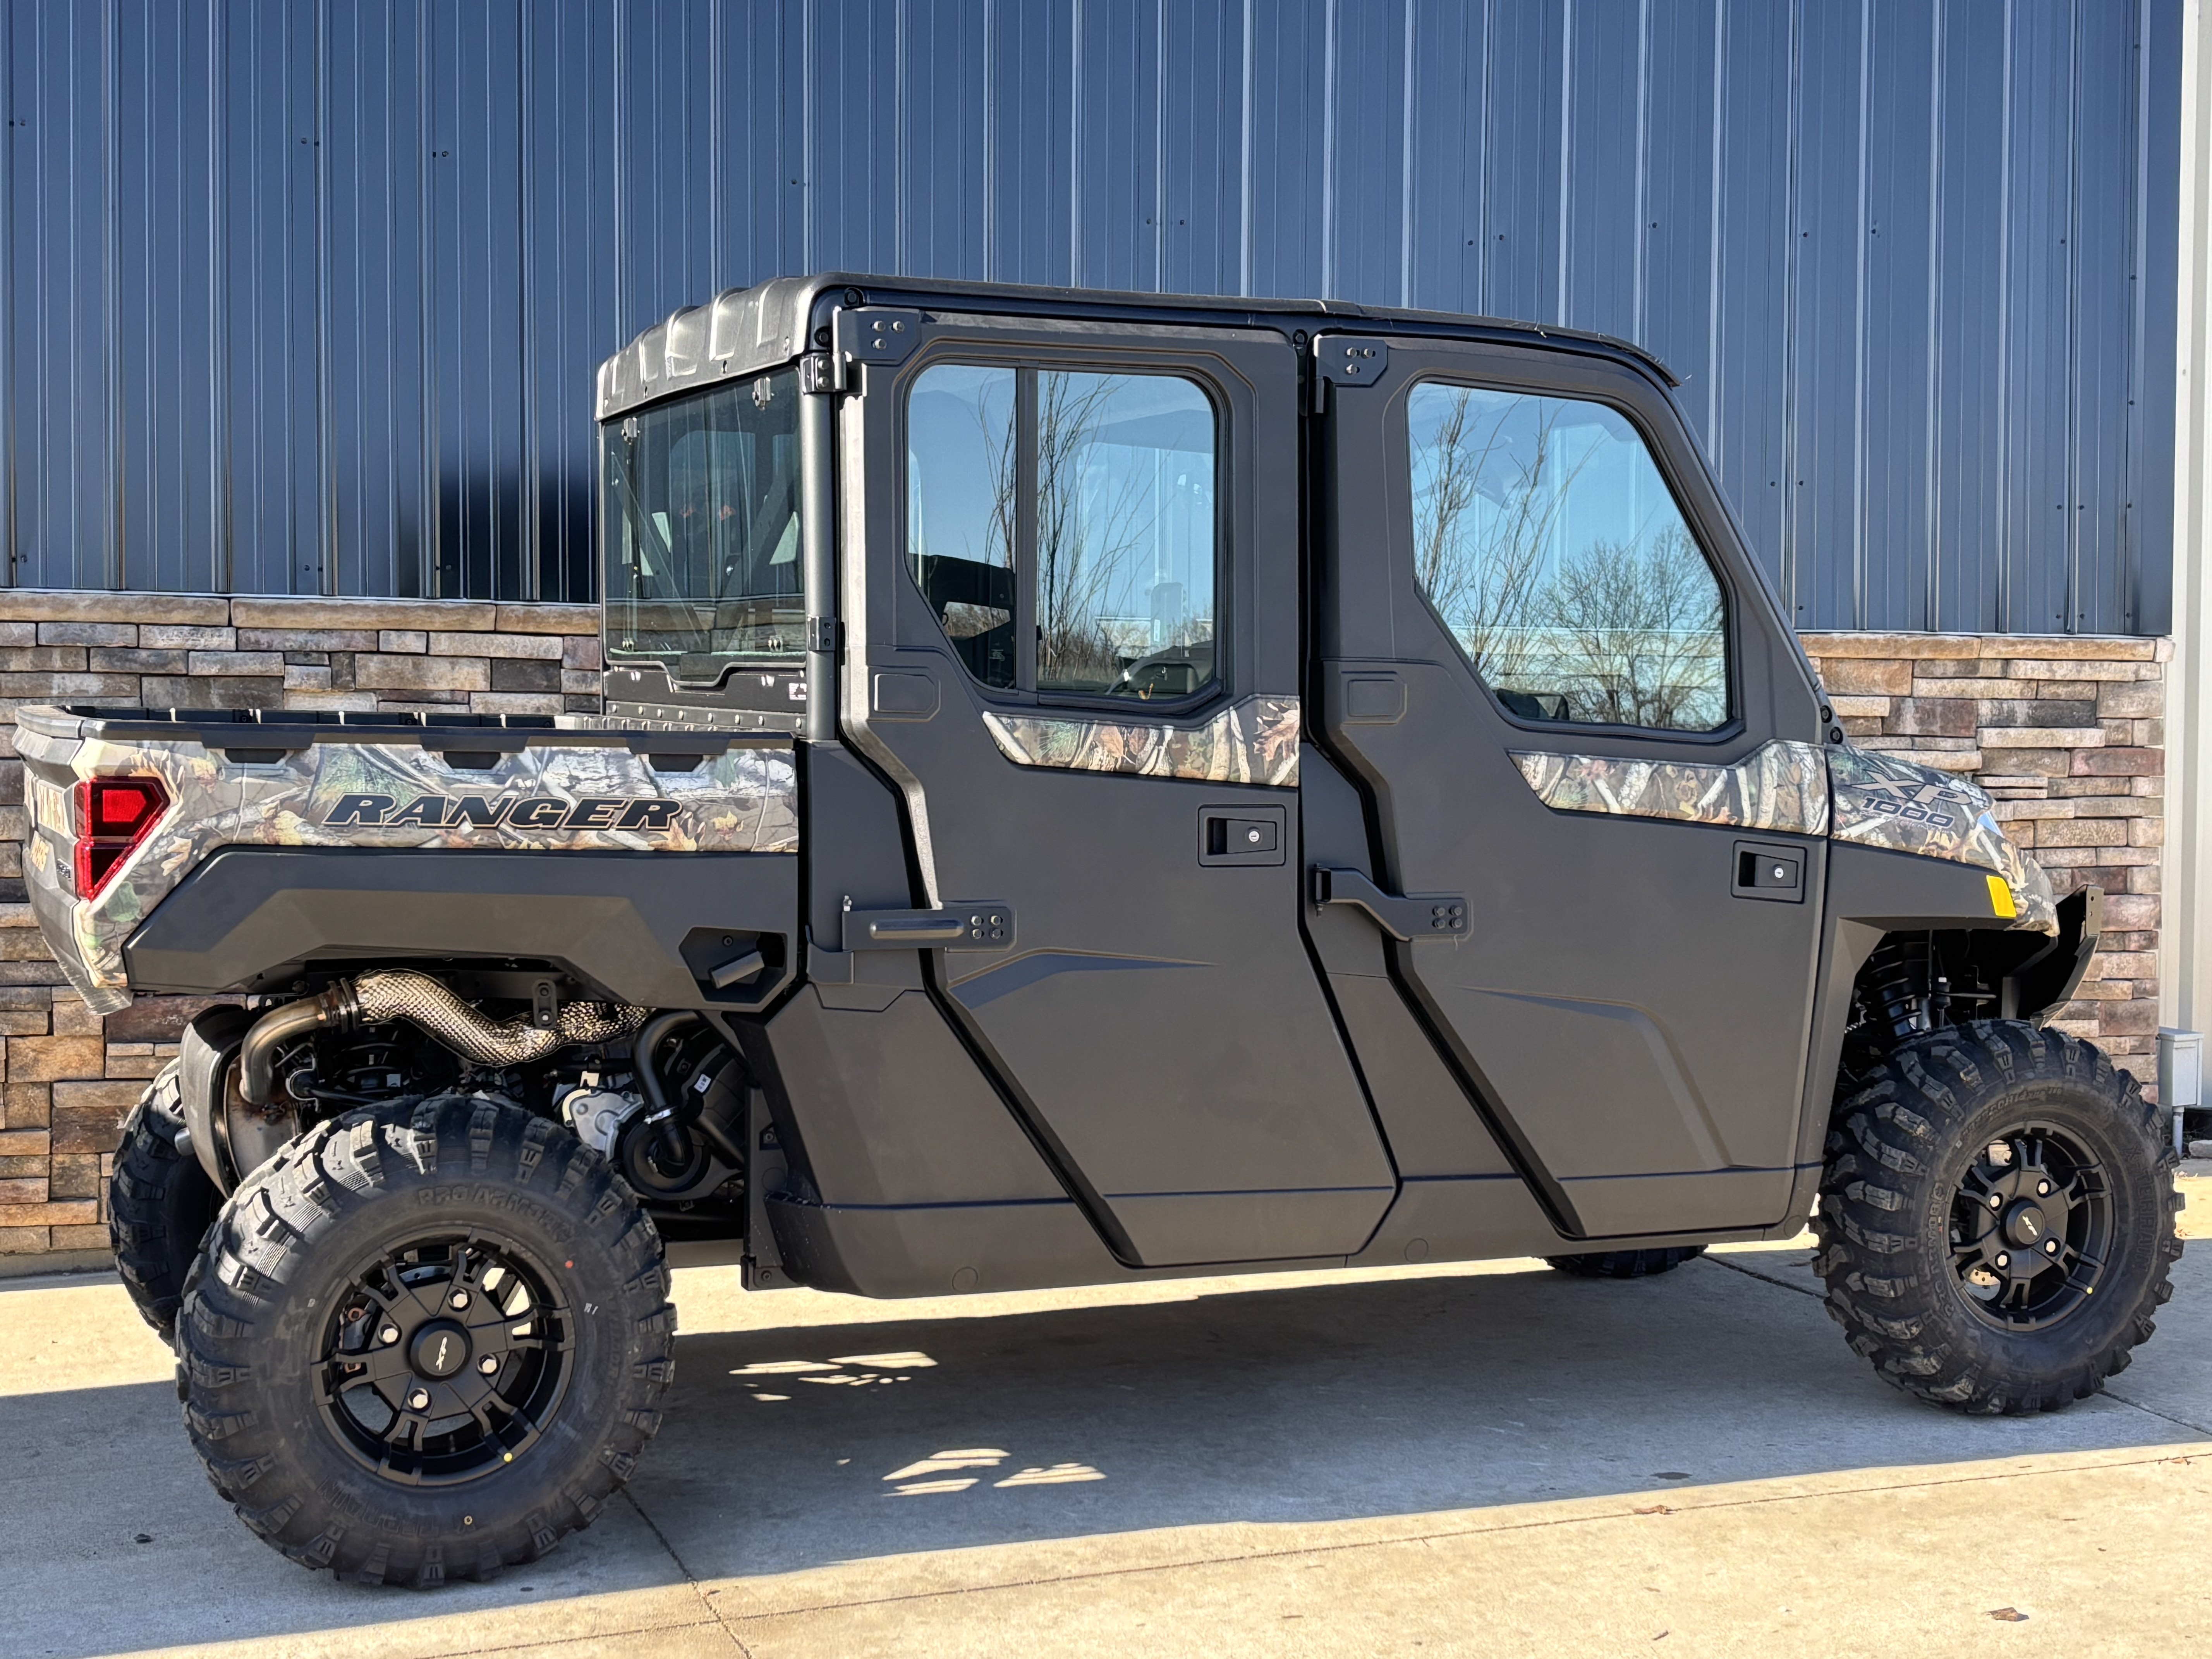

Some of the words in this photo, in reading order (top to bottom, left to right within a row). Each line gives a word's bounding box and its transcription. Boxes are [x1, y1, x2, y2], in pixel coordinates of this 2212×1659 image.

[1850, 770, 1973, 805] XP
[321, 793, 683, 831] RANGER
[1861, 796, 1955, 829] 1000
[417, 1185, 469, 1206] PRO
